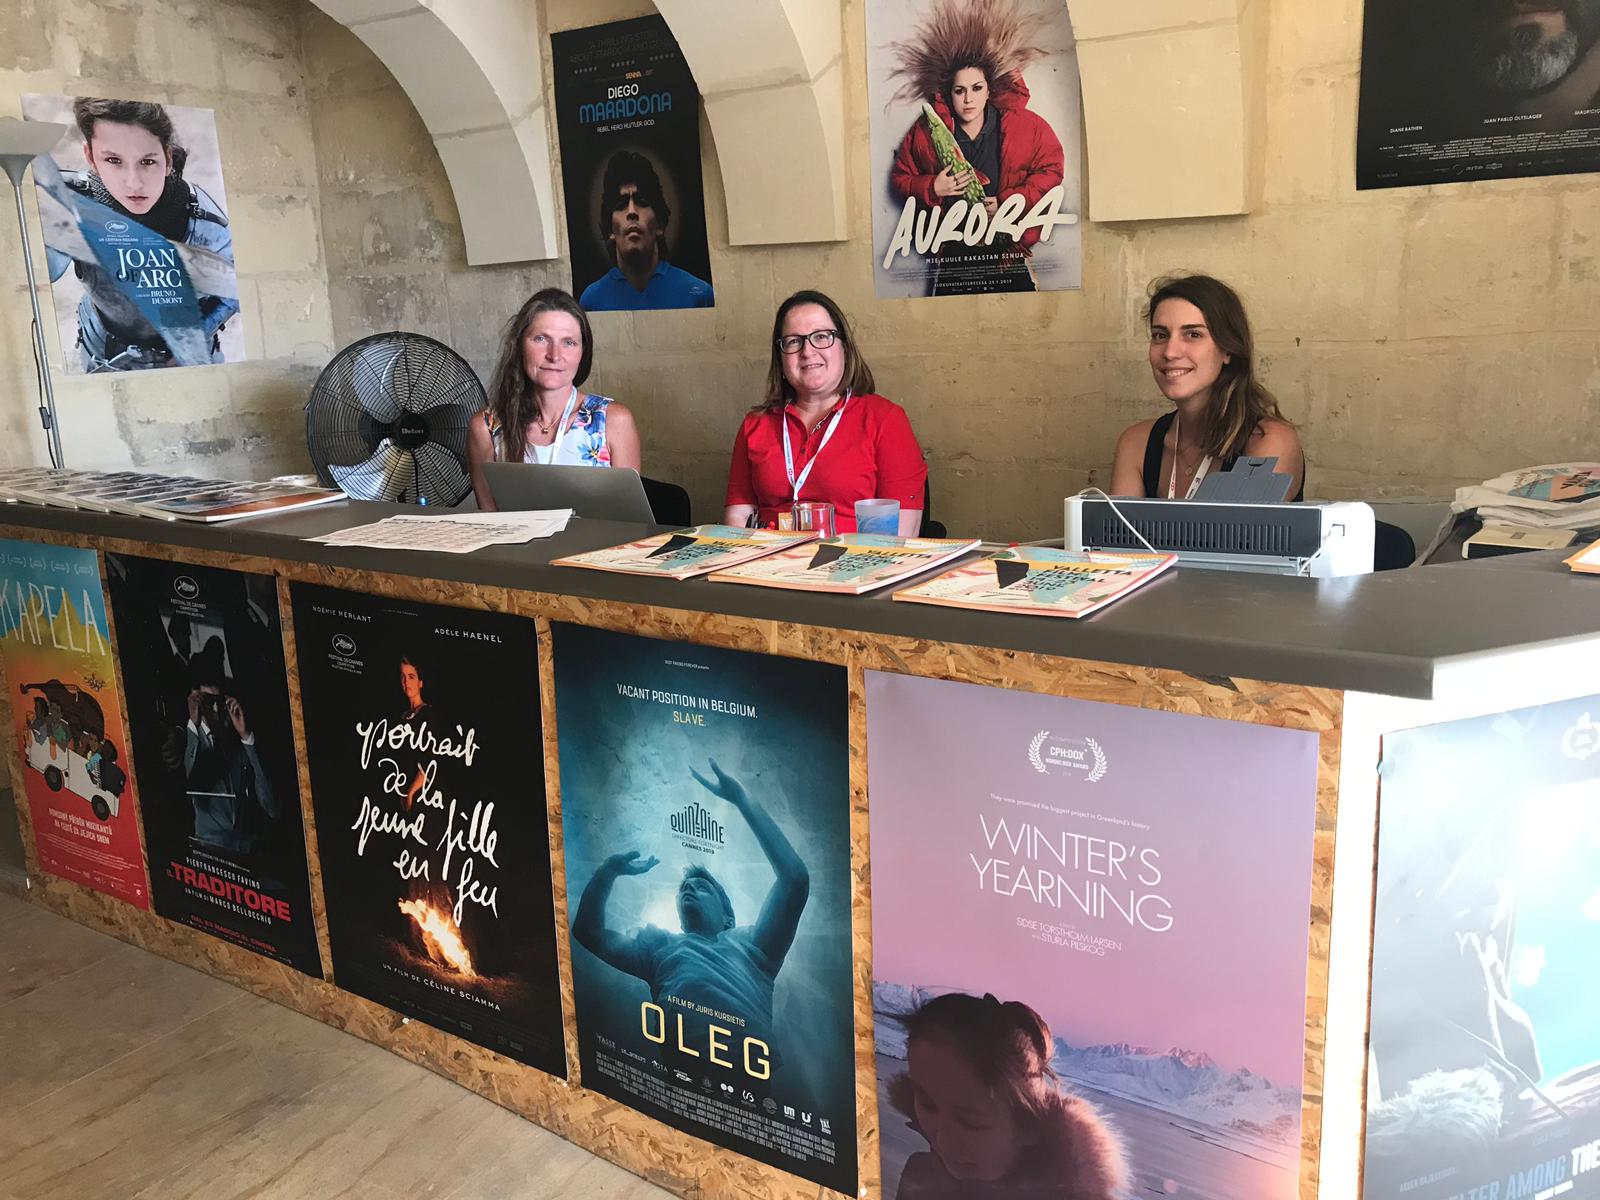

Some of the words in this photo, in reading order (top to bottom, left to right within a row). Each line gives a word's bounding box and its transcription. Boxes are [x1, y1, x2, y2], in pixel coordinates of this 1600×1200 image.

[579, 91, 672, 124] MARADONA
[607, 83, 639, 99] DIEGO
[882, 185, 1078, 270] AURORA
[117, 248, 175, 279] JOAN
[964, 253, 999, 262] RAKASTAN
[136, 268, 182, 288] ARC
[150, 289, 176, 297] BRUNO
[151, 296, 183, 305] DUMONT
[1053, 564, 1132, 576] VALLETTA
[0, 578, 106, 657] KAPELA
[462, 630, 503, 643] HAENEL
[616, 683, 651, 700] VACANT
[652, 690, 696, 708] POSITION
[698, 697, 709, 710] IN
[711, 699, 758, 719] BELGIUM.
[356, 718, 480, 770] portrait
[378, 757, 408, 798] de
[417, 759, 444, 810] la
[351, 796, 428, 856] jeune
[436, 799, 499, 881] fille
[681, 842, 702, 852] CANNES
[979, 813, 1162, 886] WINTER'S
[186, 856, 236, 881] PIERFRANCESCO
[237, 874, 261, 890] FAVINO
[393, 850, 430, 882] en
[453, 857, 499, 928] feu
[170, 861, 292, 922] TRADITORE
[969, 852, 1174, 932] YEARNING
[209, 894, 231, 909] MARCO
[232, 903, 272, 925] BELLOCCHIO
[382, 963, 392, 972] UN
[393, 967, 409, 979] FILM
[411, 974, 421, 983] DE
[459, 990, 501, 1012] SCIAMMA
[667, 994, 672, 1003] A
[672, 997, 687, 1007] FILM
[687, 1002, 695, 1010] BY
[696, 1005, 714, 1016] JURIS
[641, 1001, 771, 1080] OLEG
[1505, 1154, 1568, 1200] AMONG
